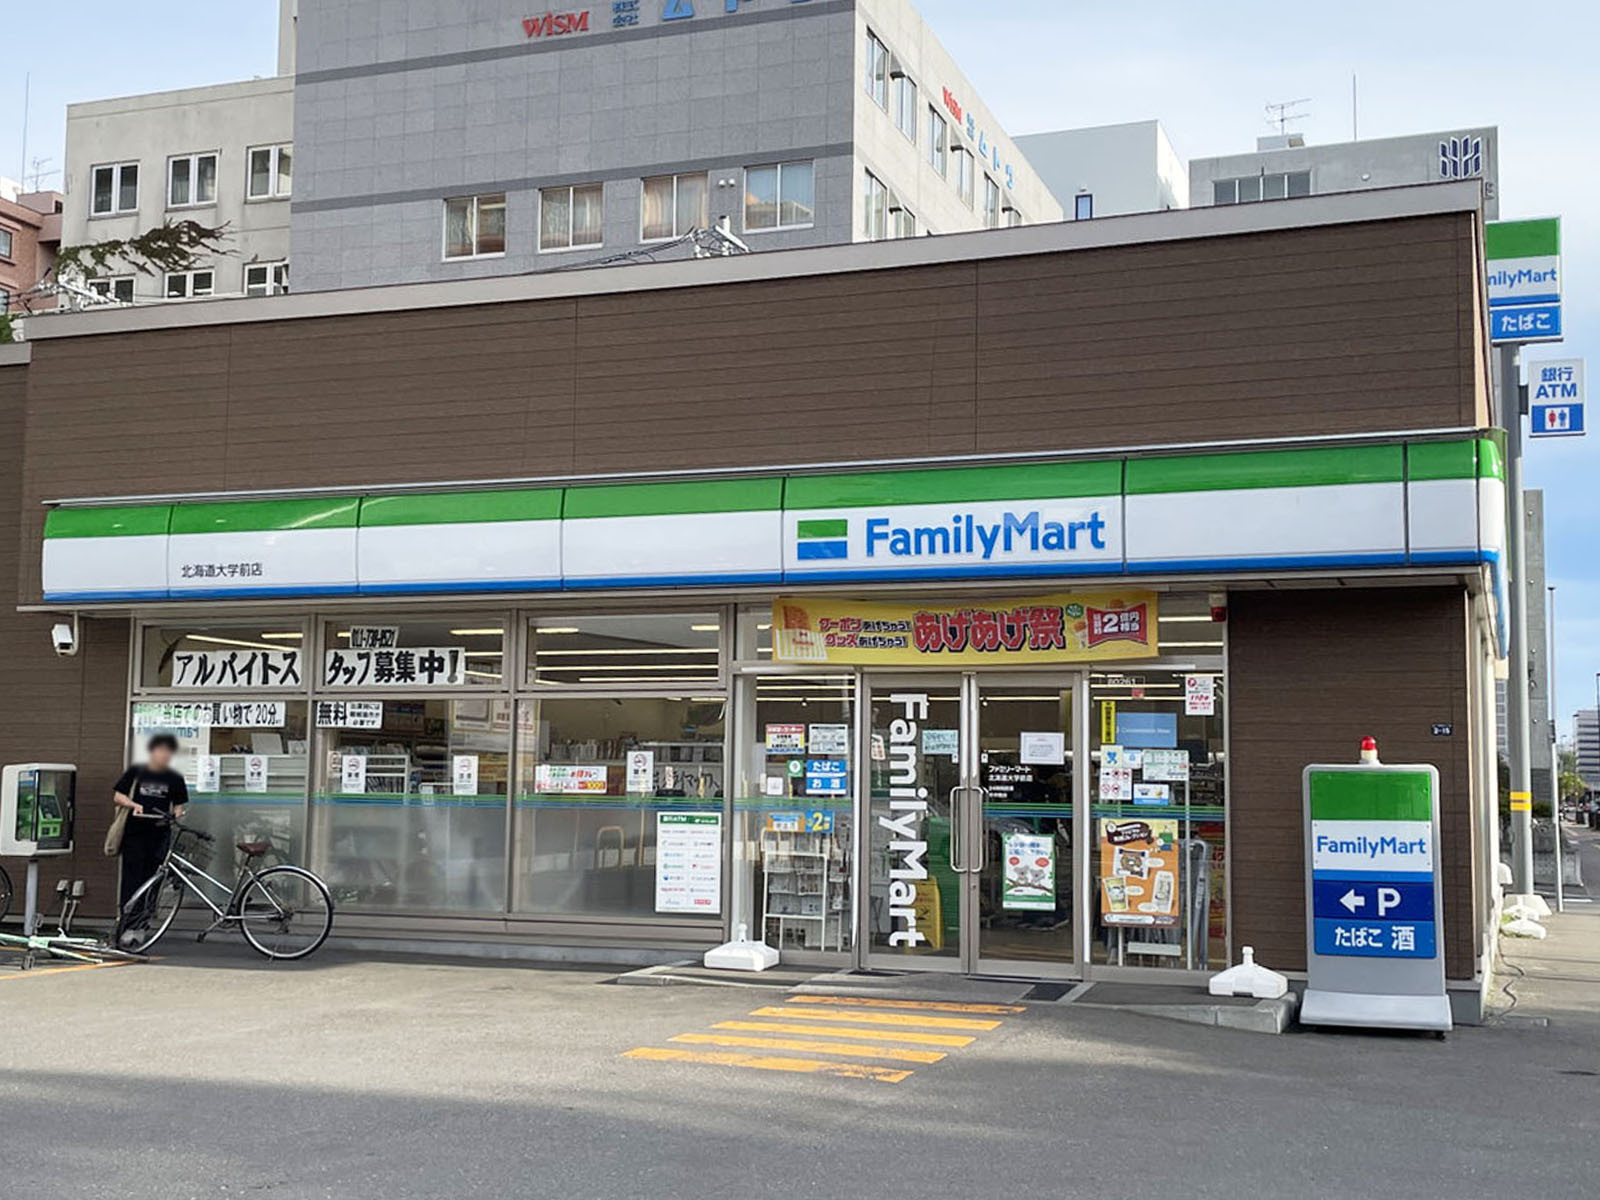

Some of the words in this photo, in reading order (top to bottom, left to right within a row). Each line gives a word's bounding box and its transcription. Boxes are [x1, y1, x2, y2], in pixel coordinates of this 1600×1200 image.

[1502, 313, 1550, 332] たばこ
[1541, 366, 1574, 382] 銀行
[1536, 383, 1577, 399] ATM
[866, 511, 1106, 559] FamilyMart
[181, 562, 263, 578] 北海道大学前店
[913, 605, 1066, 652] あげあげ祭
[317, 703, 347, 725] 無料
[812, 761, 840, 772] たばこ
[879, 693, 928, 947] FamilyMart
[1316, 835, 1426, 858] FamilyMart
[1378, 888, 1401, 916] P
[1335, 926, 1383, 948] たばこ
[1391, 926, 1415, 950] 酒
